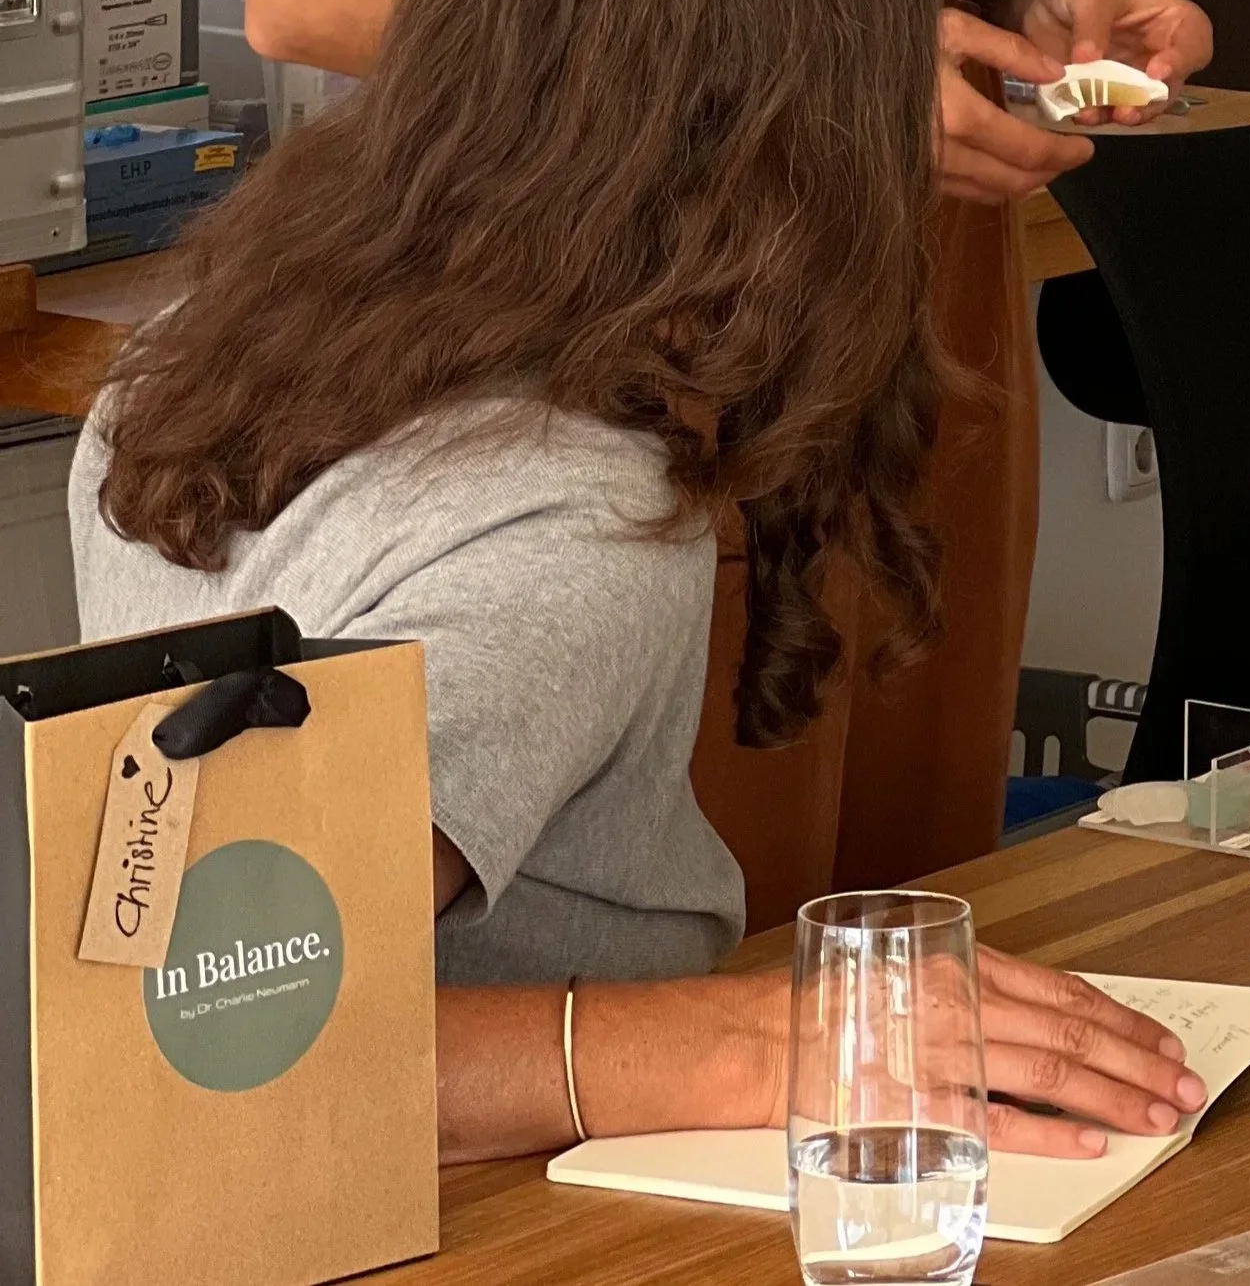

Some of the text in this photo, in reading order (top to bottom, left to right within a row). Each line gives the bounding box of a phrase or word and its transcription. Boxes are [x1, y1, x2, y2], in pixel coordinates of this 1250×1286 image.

[115, 767, 173, 937] Christine
[156, 931, 330, 1000] In Balance.
[180, 977, 310, 1019] by Dr Charlie Neumann
